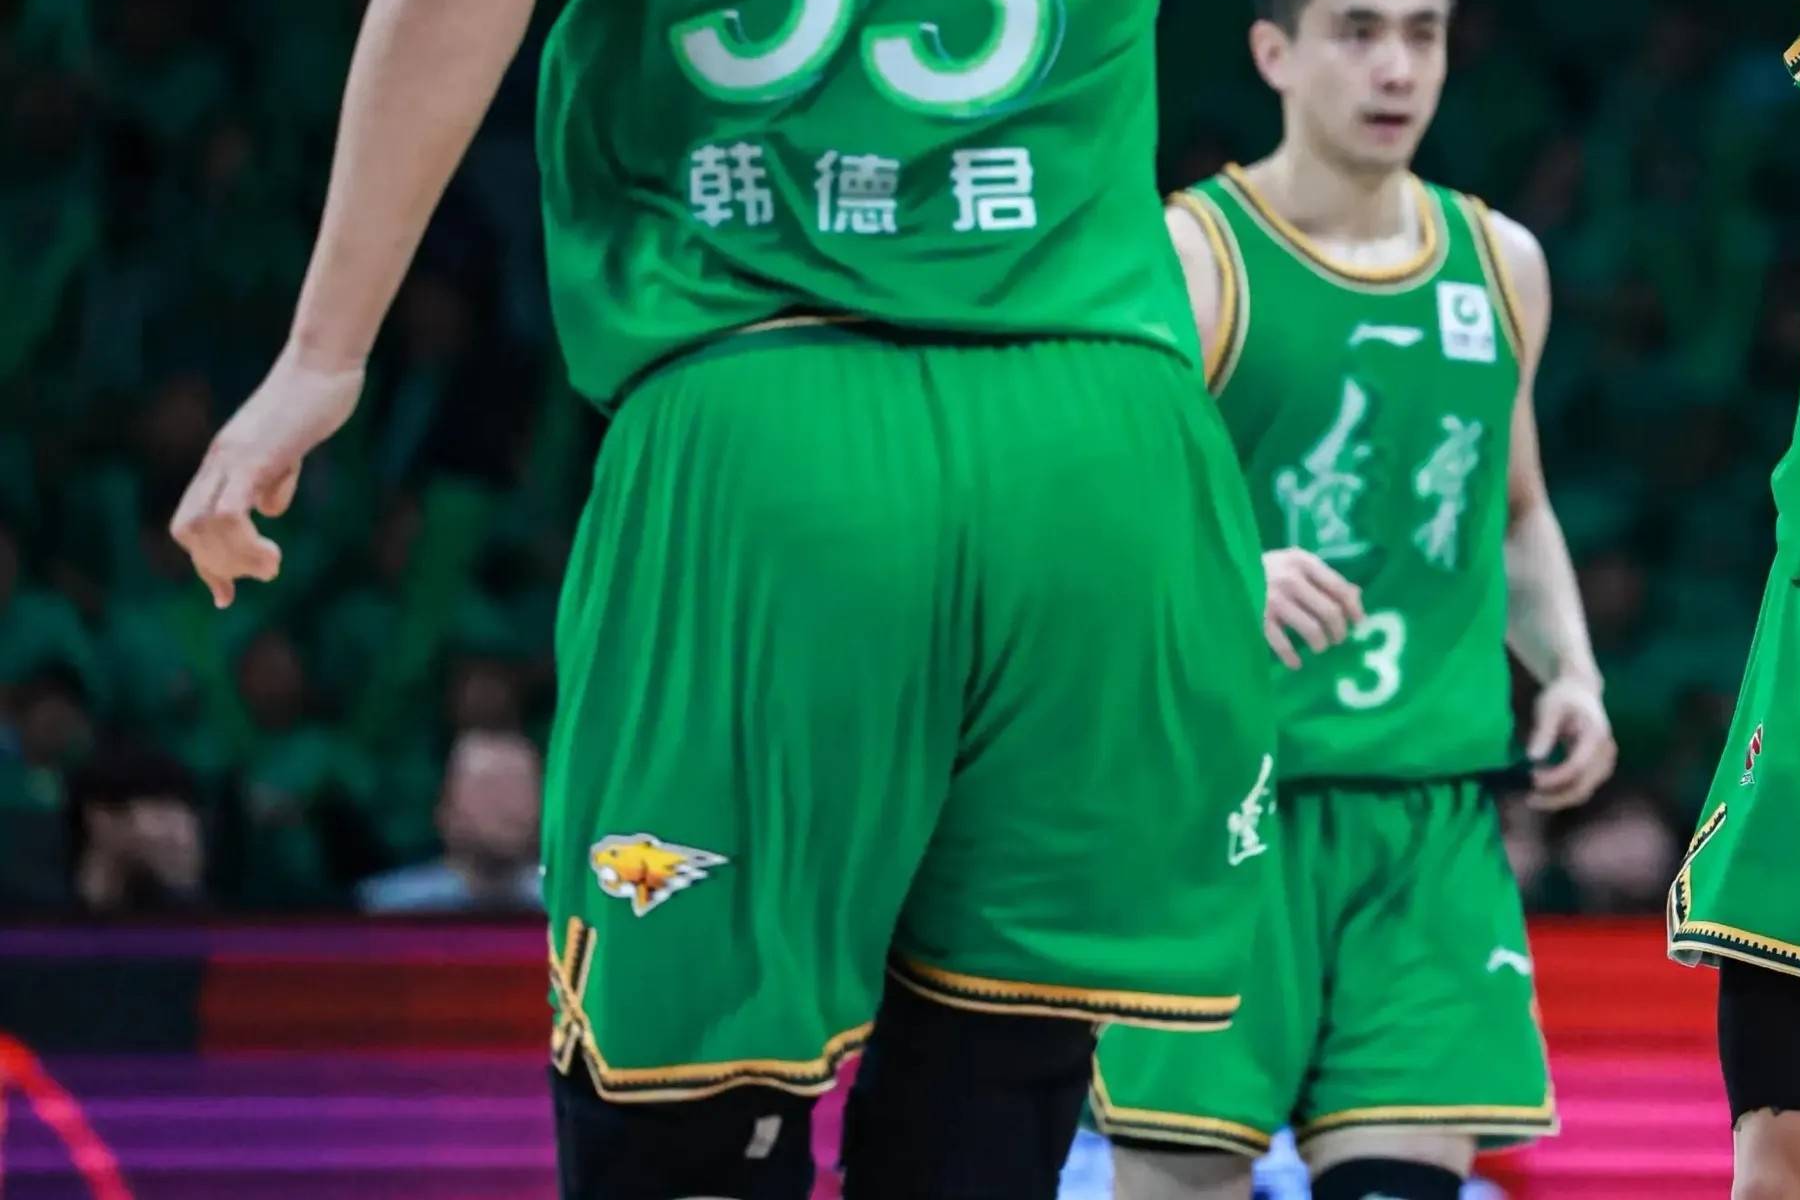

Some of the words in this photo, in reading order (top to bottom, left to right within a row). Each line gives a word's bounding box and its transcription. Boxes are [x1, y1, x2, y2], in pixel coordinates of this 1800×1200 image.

[689, 141, 1038, 234] 韩德君
[1336, 610, 1409, 711] 3
